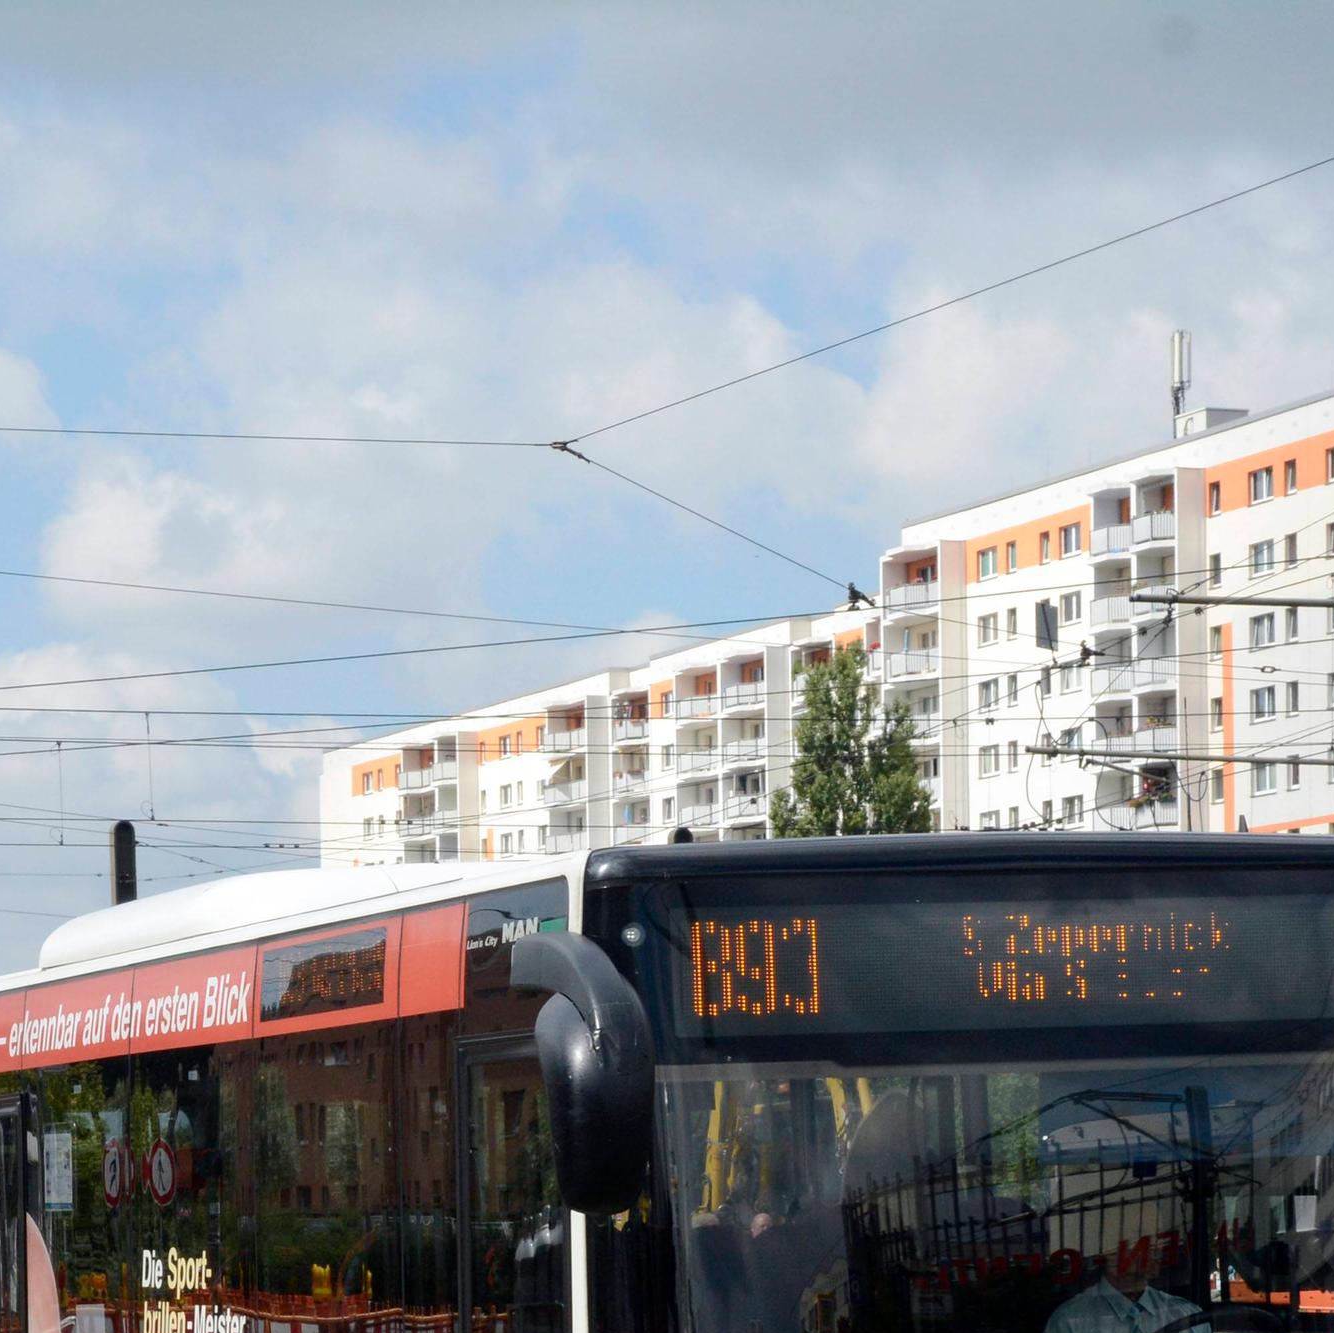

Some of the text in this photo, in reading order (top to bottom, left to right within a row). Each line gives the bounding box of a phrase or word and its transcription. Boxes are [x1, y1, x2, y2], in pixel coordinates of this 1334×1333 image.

[485, 936, 498, 948] City
[502, 917, 539, 944] MAN
[9, 1008, 82, 1057] erkennbar
[84, 994, 110, 1040] auf
[111, 993, 141, 1041] den
[145, 985, 199, 1036] ersten
[201, 971, 251, 1028] Blick
[141, 1247, 212, 1300] Die Sport-
